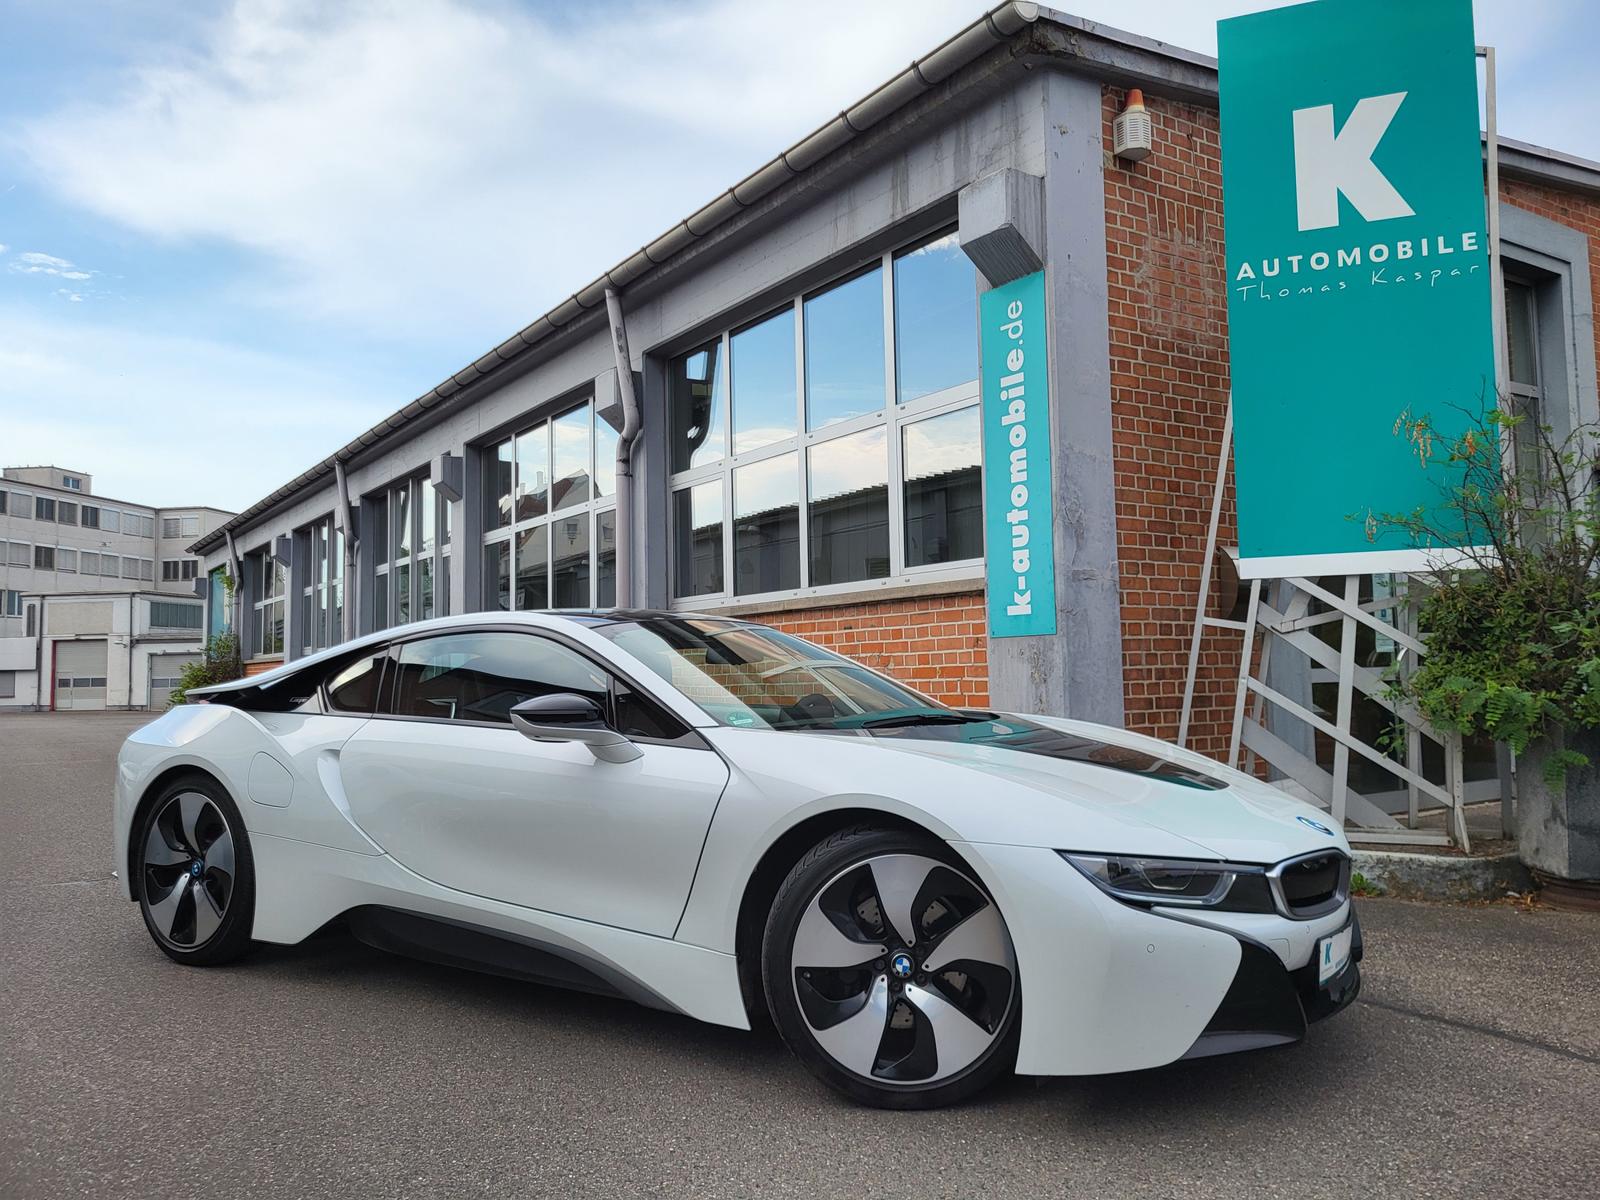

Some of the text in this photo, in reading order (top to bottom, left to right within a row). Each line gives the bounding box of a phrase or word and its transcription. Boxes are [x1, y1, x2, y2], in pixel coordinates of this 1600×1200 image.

[1292, 90, 1417, 232] K
[1236, 231, 1479, 281] AUTOMOBILE
[1236, 264, 1480, 302] Thomas Kaspar
[1000, 299, 1032, 616] k-automobile.de
